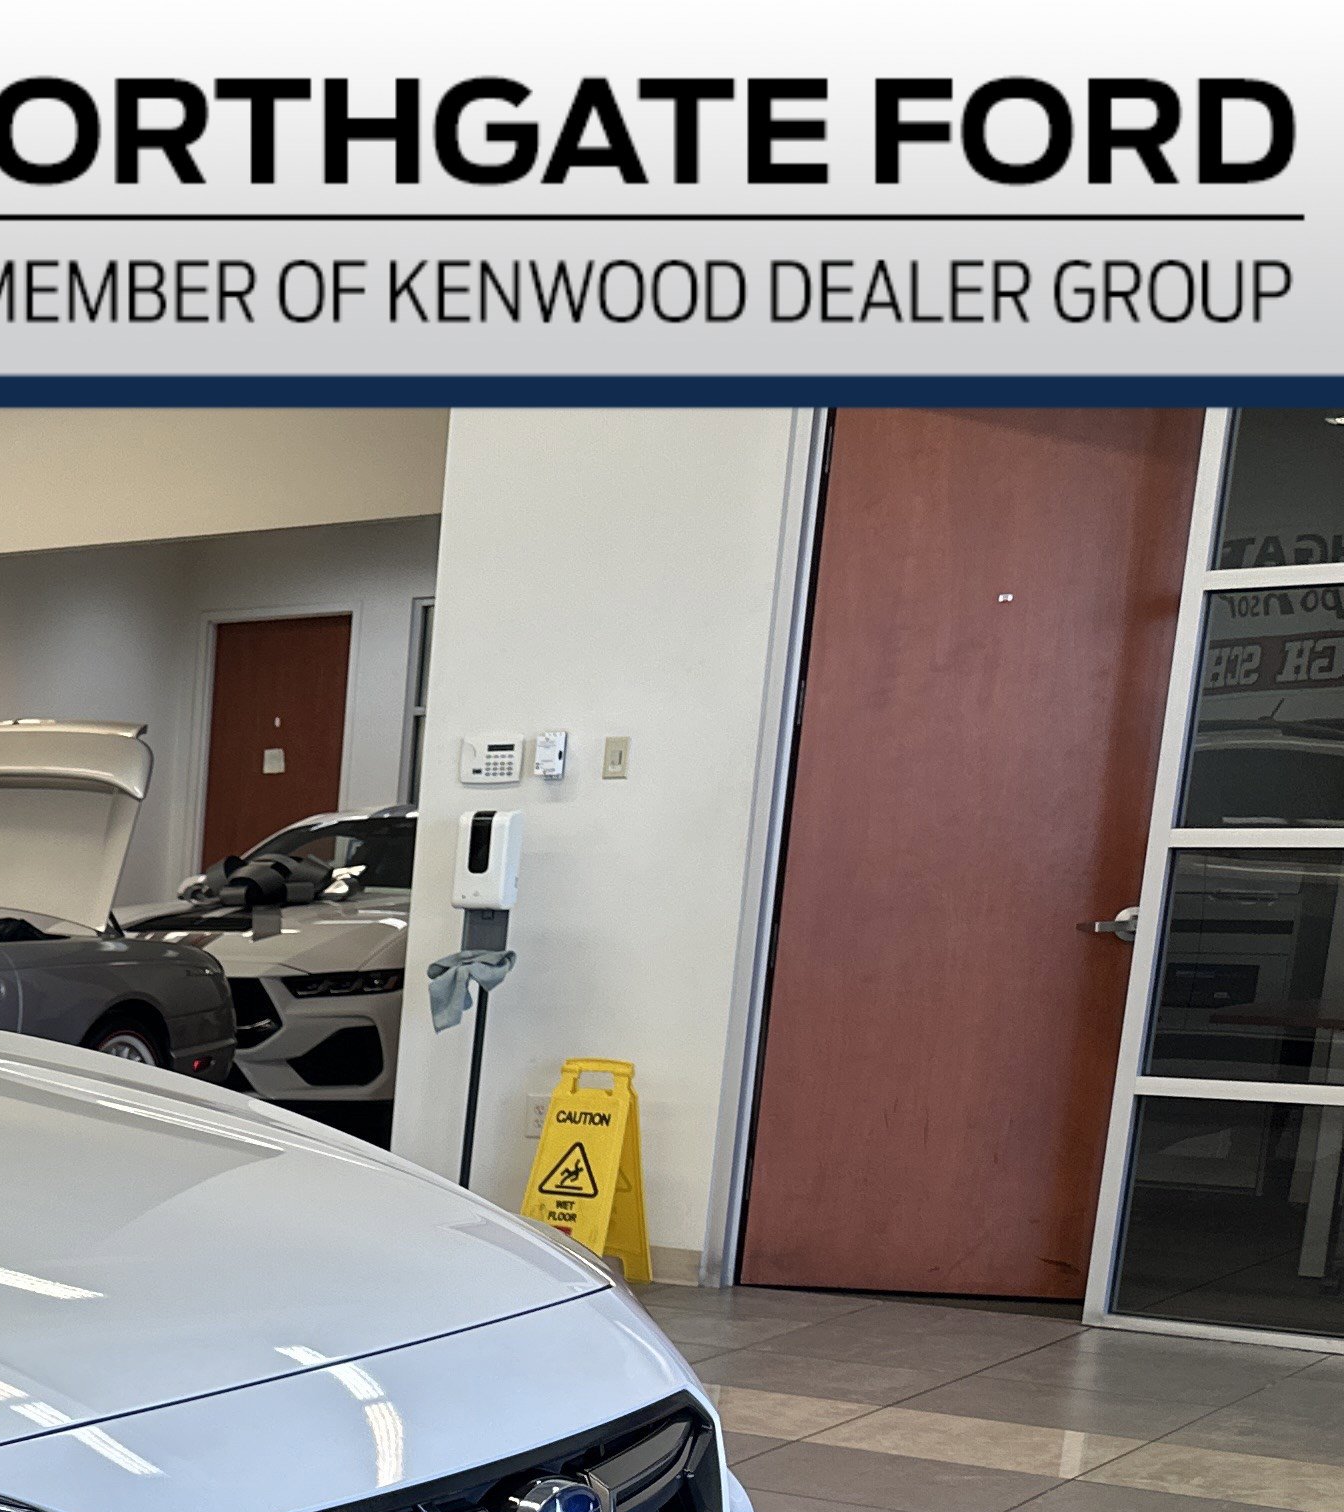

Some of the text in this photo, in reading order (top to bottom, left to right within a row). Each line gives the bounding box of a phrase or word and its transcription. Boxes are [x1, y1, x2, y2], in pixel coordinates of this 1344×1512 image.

[556, 1110, 611, 1127] CAUTION
[555, 1200, 575, 1211] WET
[547, 1211, 577, 1222] FLOOR
